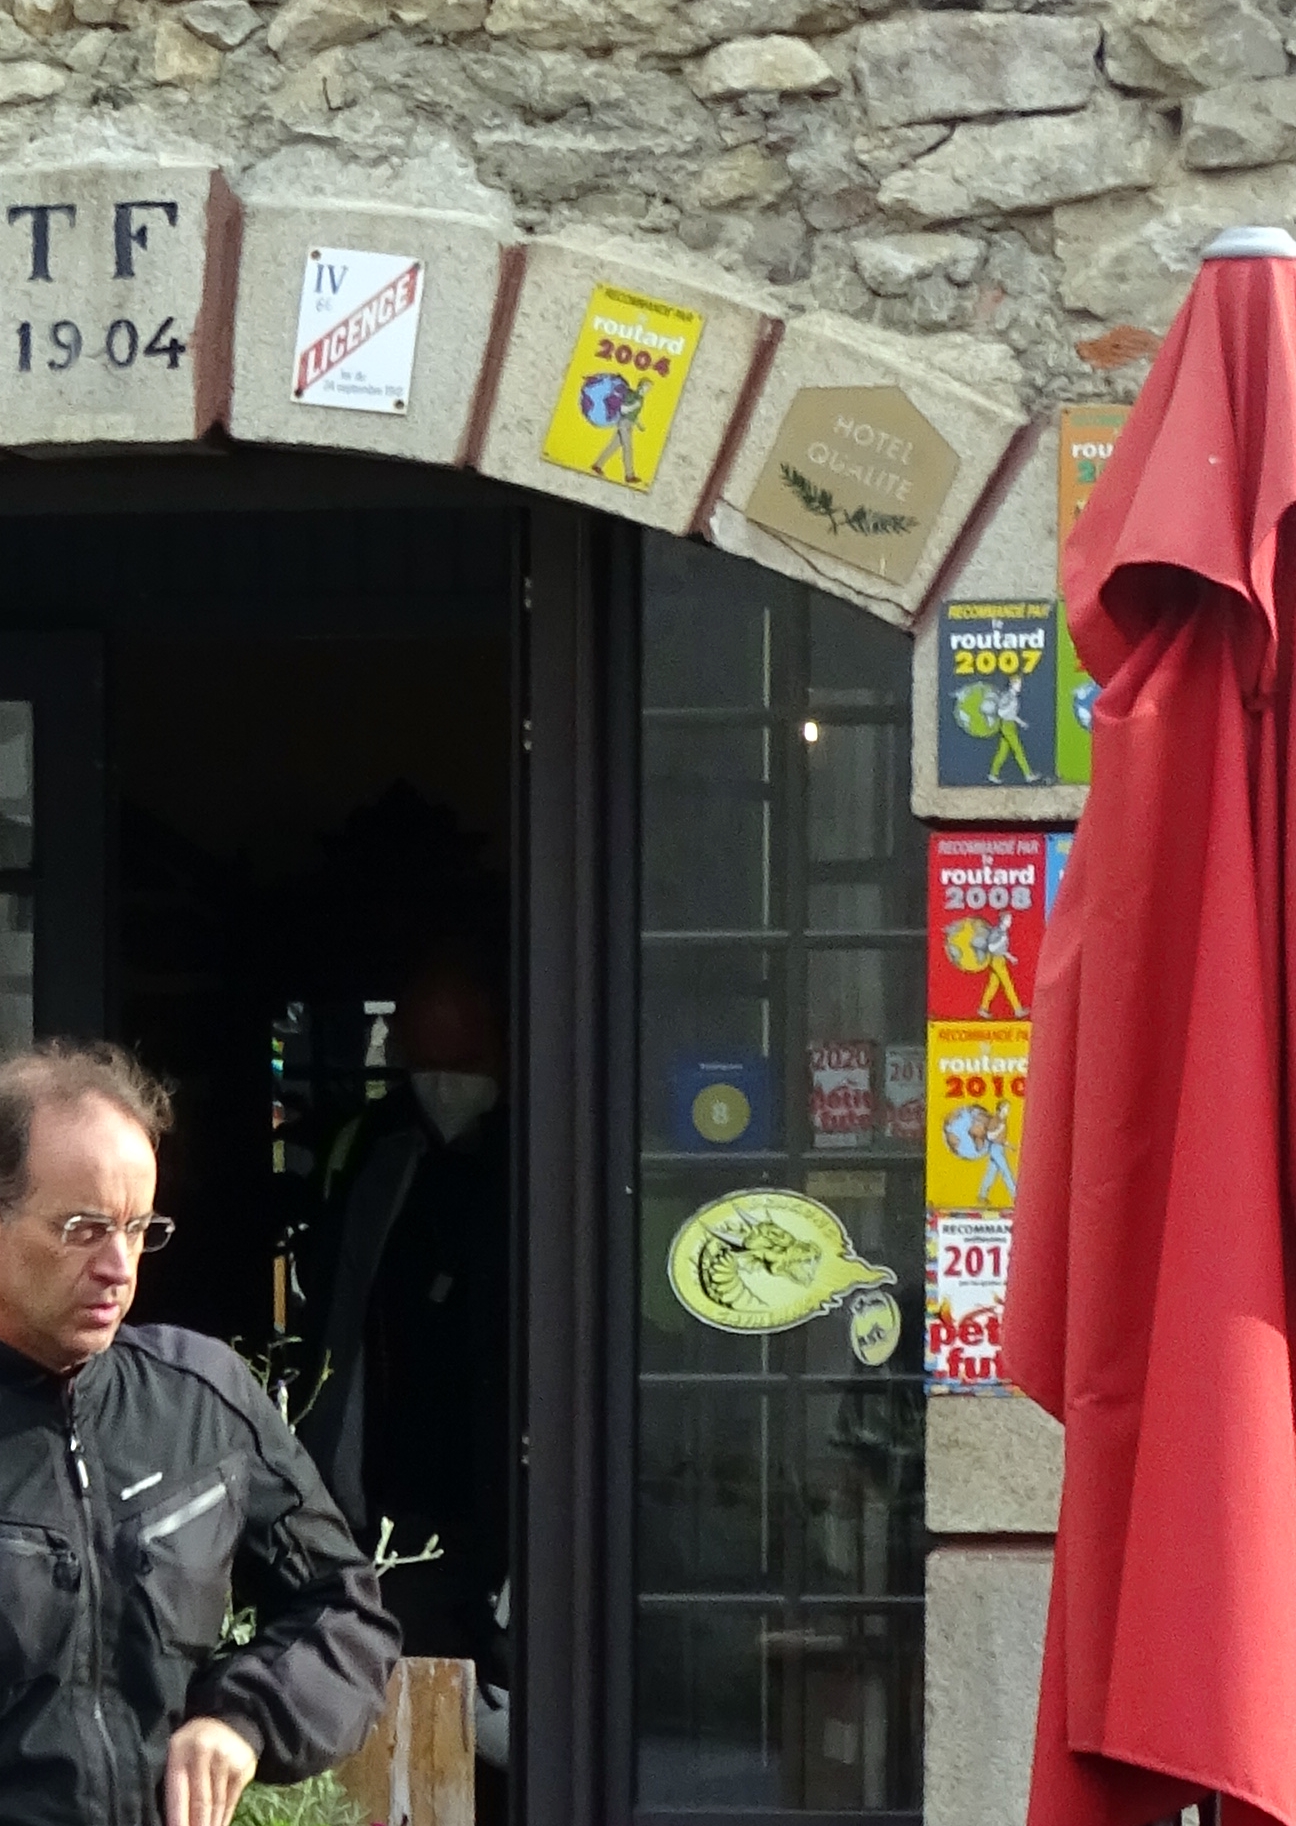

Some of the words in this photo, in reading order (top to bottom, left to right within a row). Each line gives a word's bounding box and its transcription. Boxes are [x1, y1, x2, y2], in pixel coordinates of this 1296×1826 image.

[7, 203, 76, 282] T
[113, 201, 178, 280] F
[315, 263, 349, 295] IV
[16, 316, 186, 373] 1904
[305, 274, 411, 383] LICENCE
[593, 315, 686, 356] routard
[594, 339, 671, 378] 2004
[950, 629, 1045, 650] routard
[954, 650, 1042, 675] 2007
[940, 864, 1035, 885] routard
[944, 886, 1032, 910] 2008
[942, 1223, 1013, 1235] RECOMMAN
[944, 1246, 1002, 1278] 201
[929, 1315, 1002, 1354] pet
